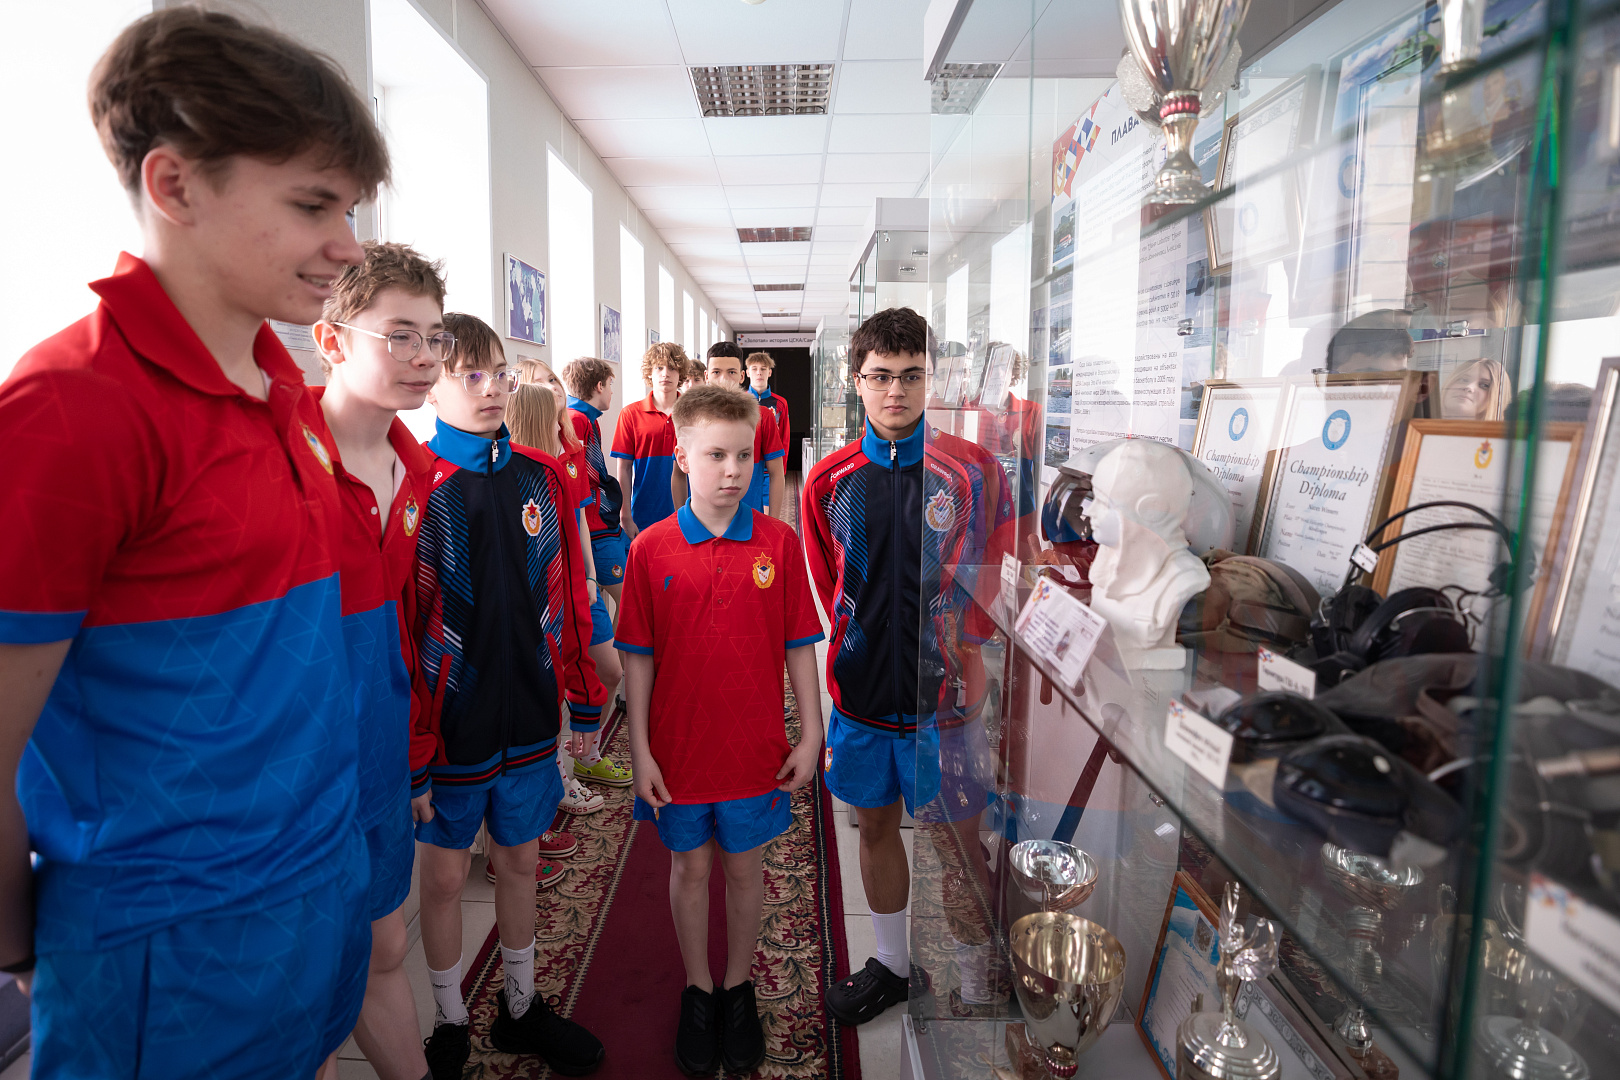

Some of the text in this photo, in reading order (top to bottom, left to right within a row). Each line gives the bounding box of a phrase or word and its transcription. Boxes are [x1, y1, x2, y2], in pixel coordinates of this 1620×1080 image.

[1205, 449, 1260, 470] Championship
[829, 462, 855, 482] FORWARD
[1213, 466, 1245, 482] Diploma
[1290, 460, 1369, 486] Championship
[1299, 480, 1347, 501] Diploma
[563, 805, 588, 813] crocs
